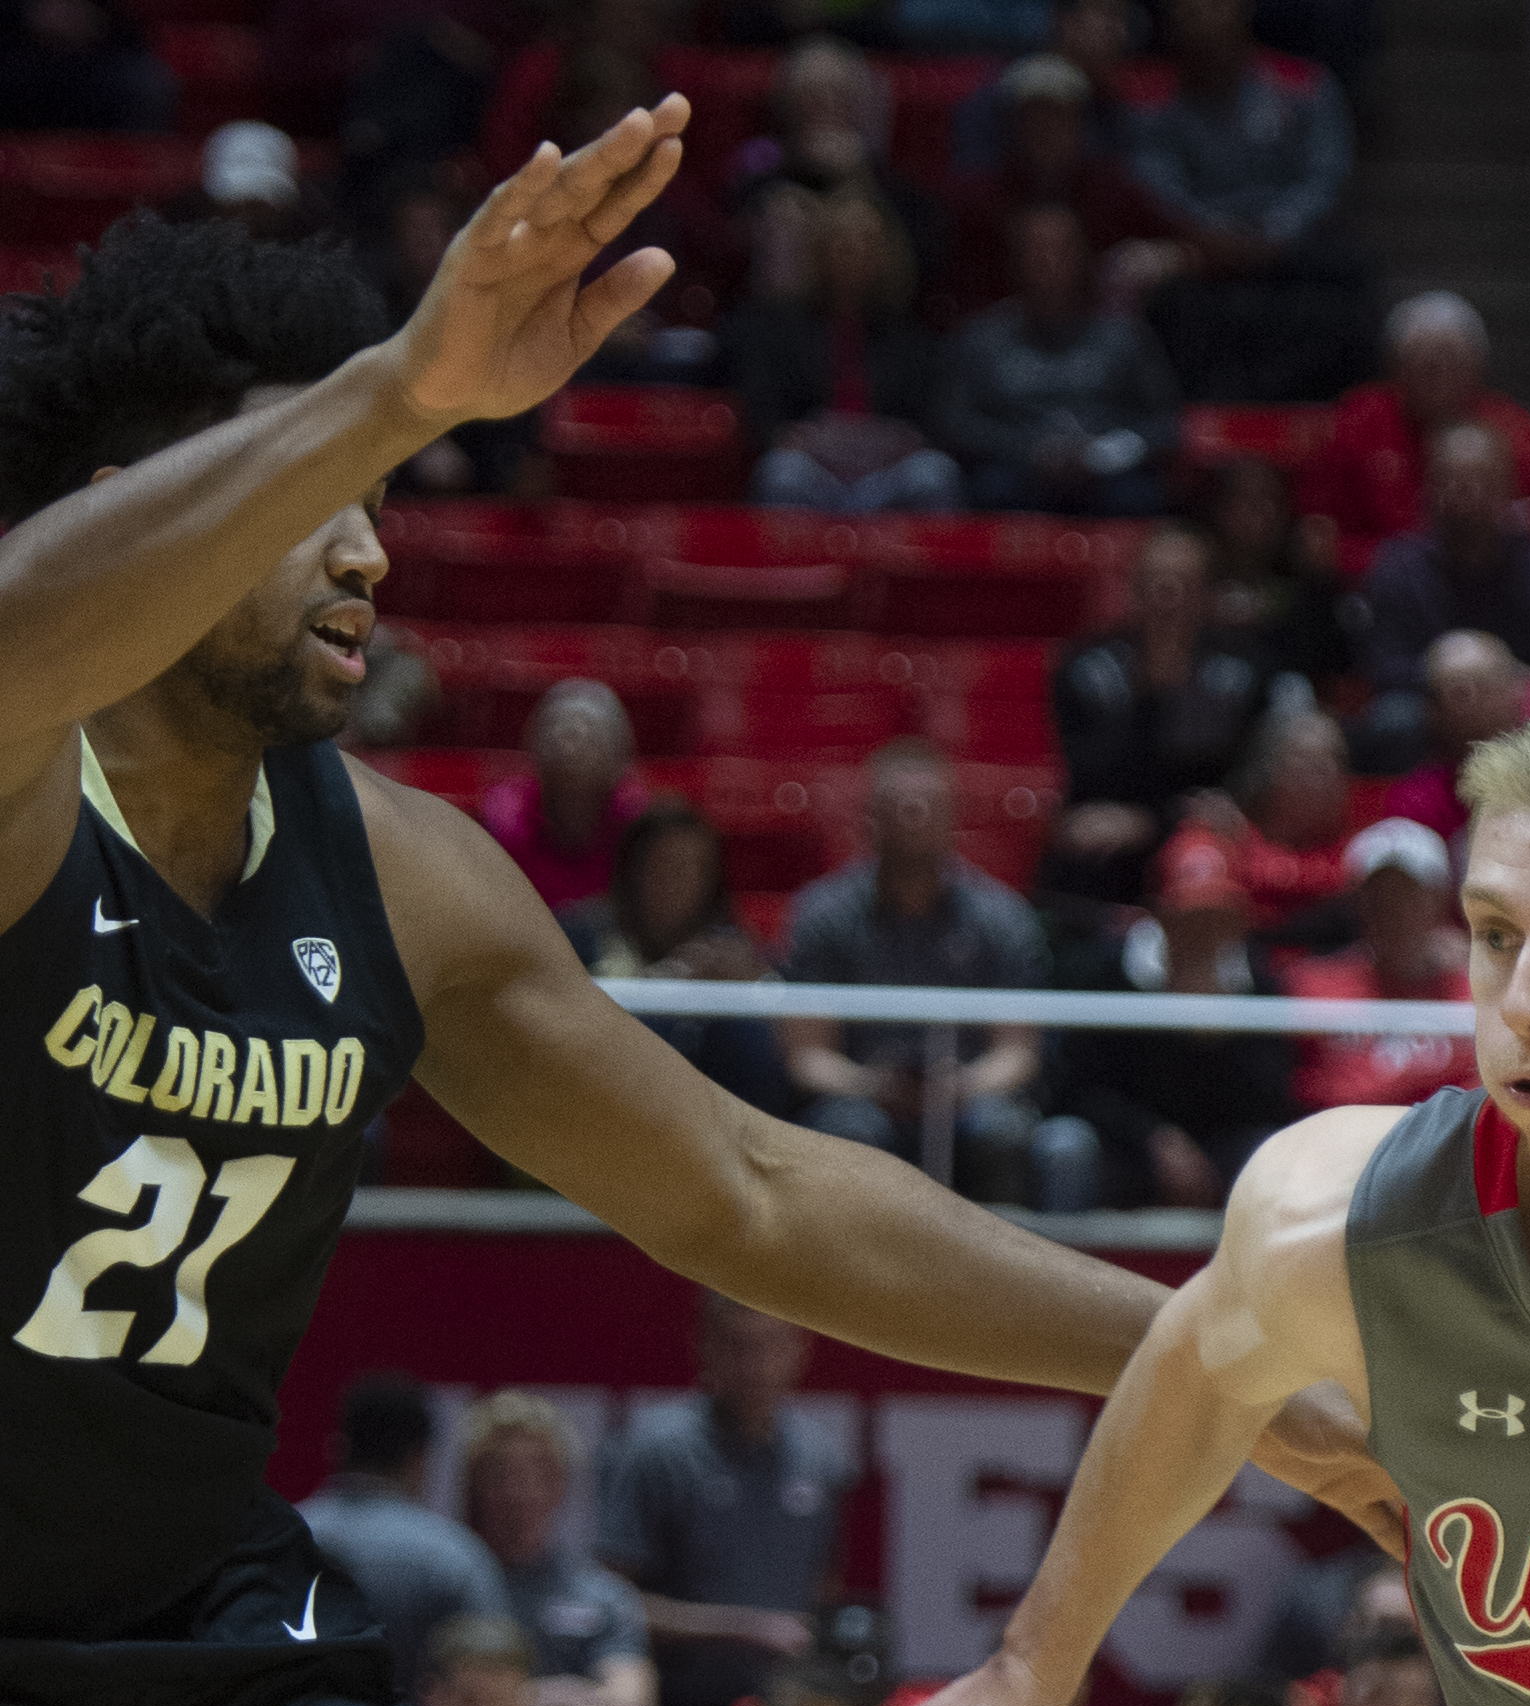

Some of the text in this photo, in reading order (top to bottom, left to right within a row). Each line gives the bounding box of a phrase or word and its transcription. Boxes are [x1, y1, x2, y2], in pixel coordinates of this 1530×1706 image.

[310, 964, 335, 987] 12
[44, 984, 365, 1126] COLORADO
[12, 1134, 297, 1366] 21
